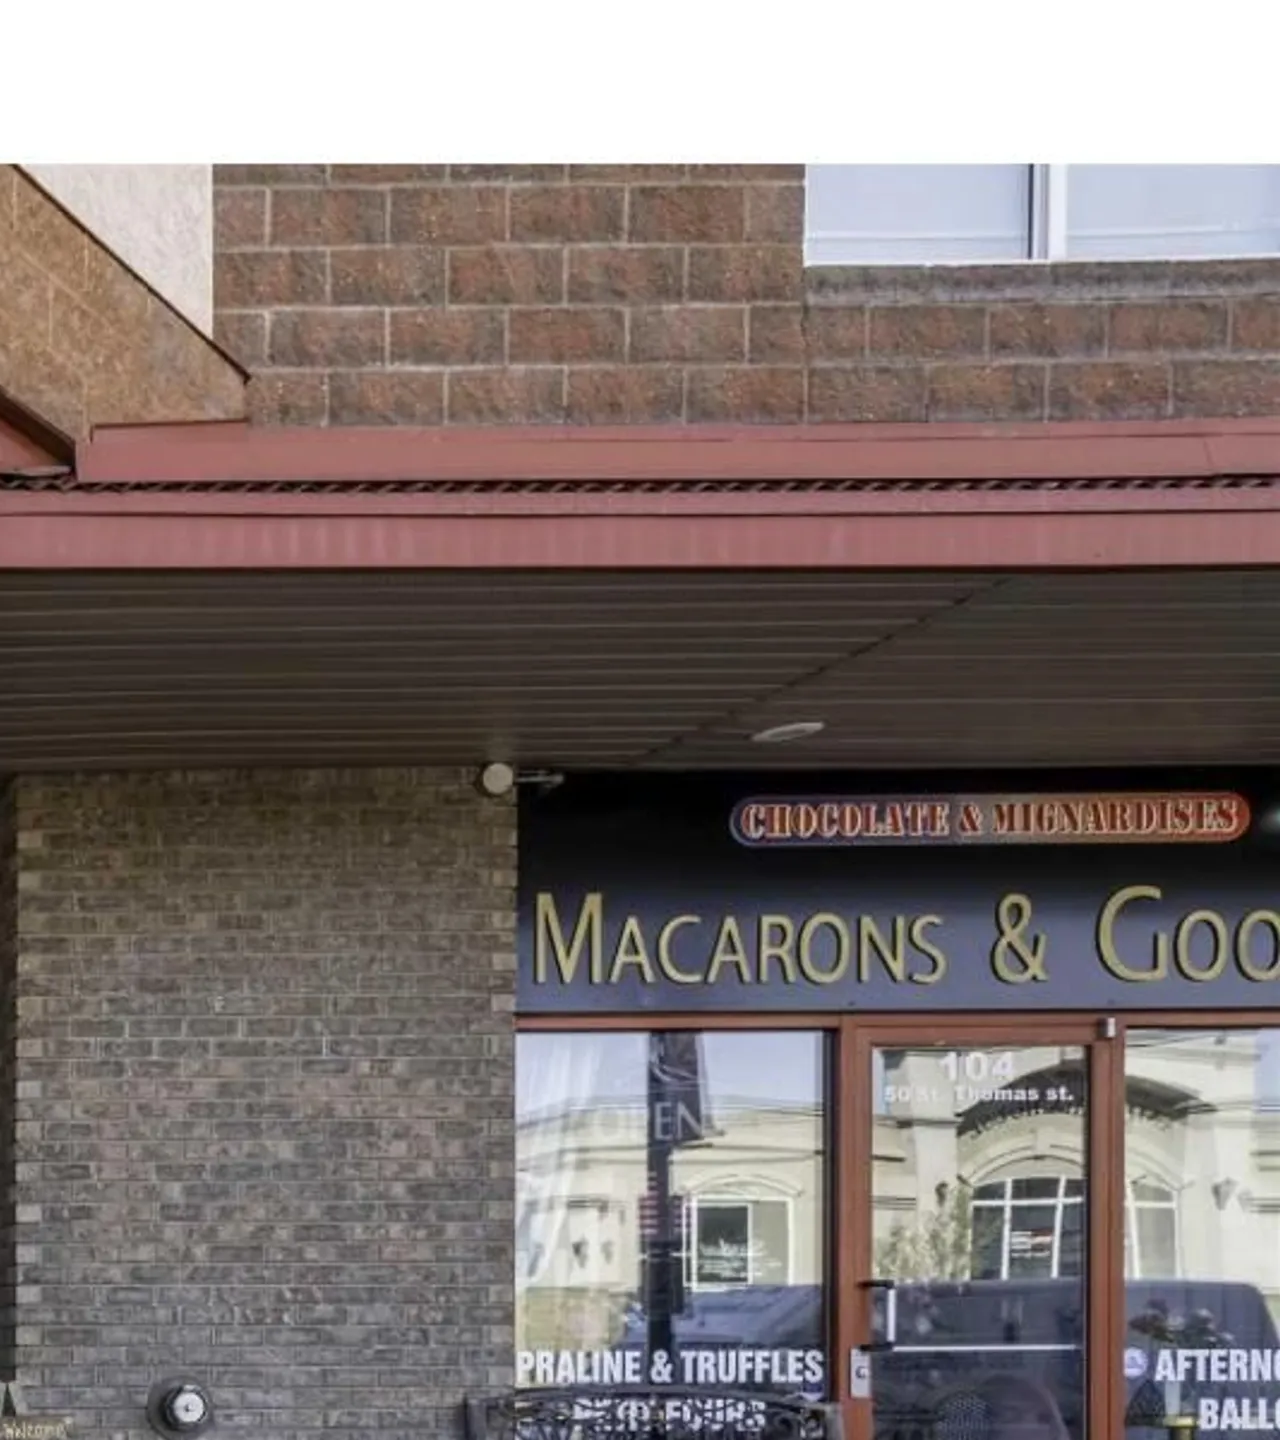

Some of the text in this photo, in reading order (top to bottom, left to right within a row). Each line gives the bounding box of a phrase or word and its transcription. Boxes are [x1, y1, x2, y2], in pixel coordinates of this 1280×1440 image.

[741, 799, 1238, 839] CHOCOLATE & MIGNARDISES
[534, 891, 948, 985] MACARONS
[991, 893, 1048, 983] &
[940, 1051, 1014, 1081] 104
[954, 1085, 1039, 1101] Thomas
[515, 1350, 825, 1387] PRALINE & TRUFFLES
[1198, 1398, 1280, 1430] BALL
